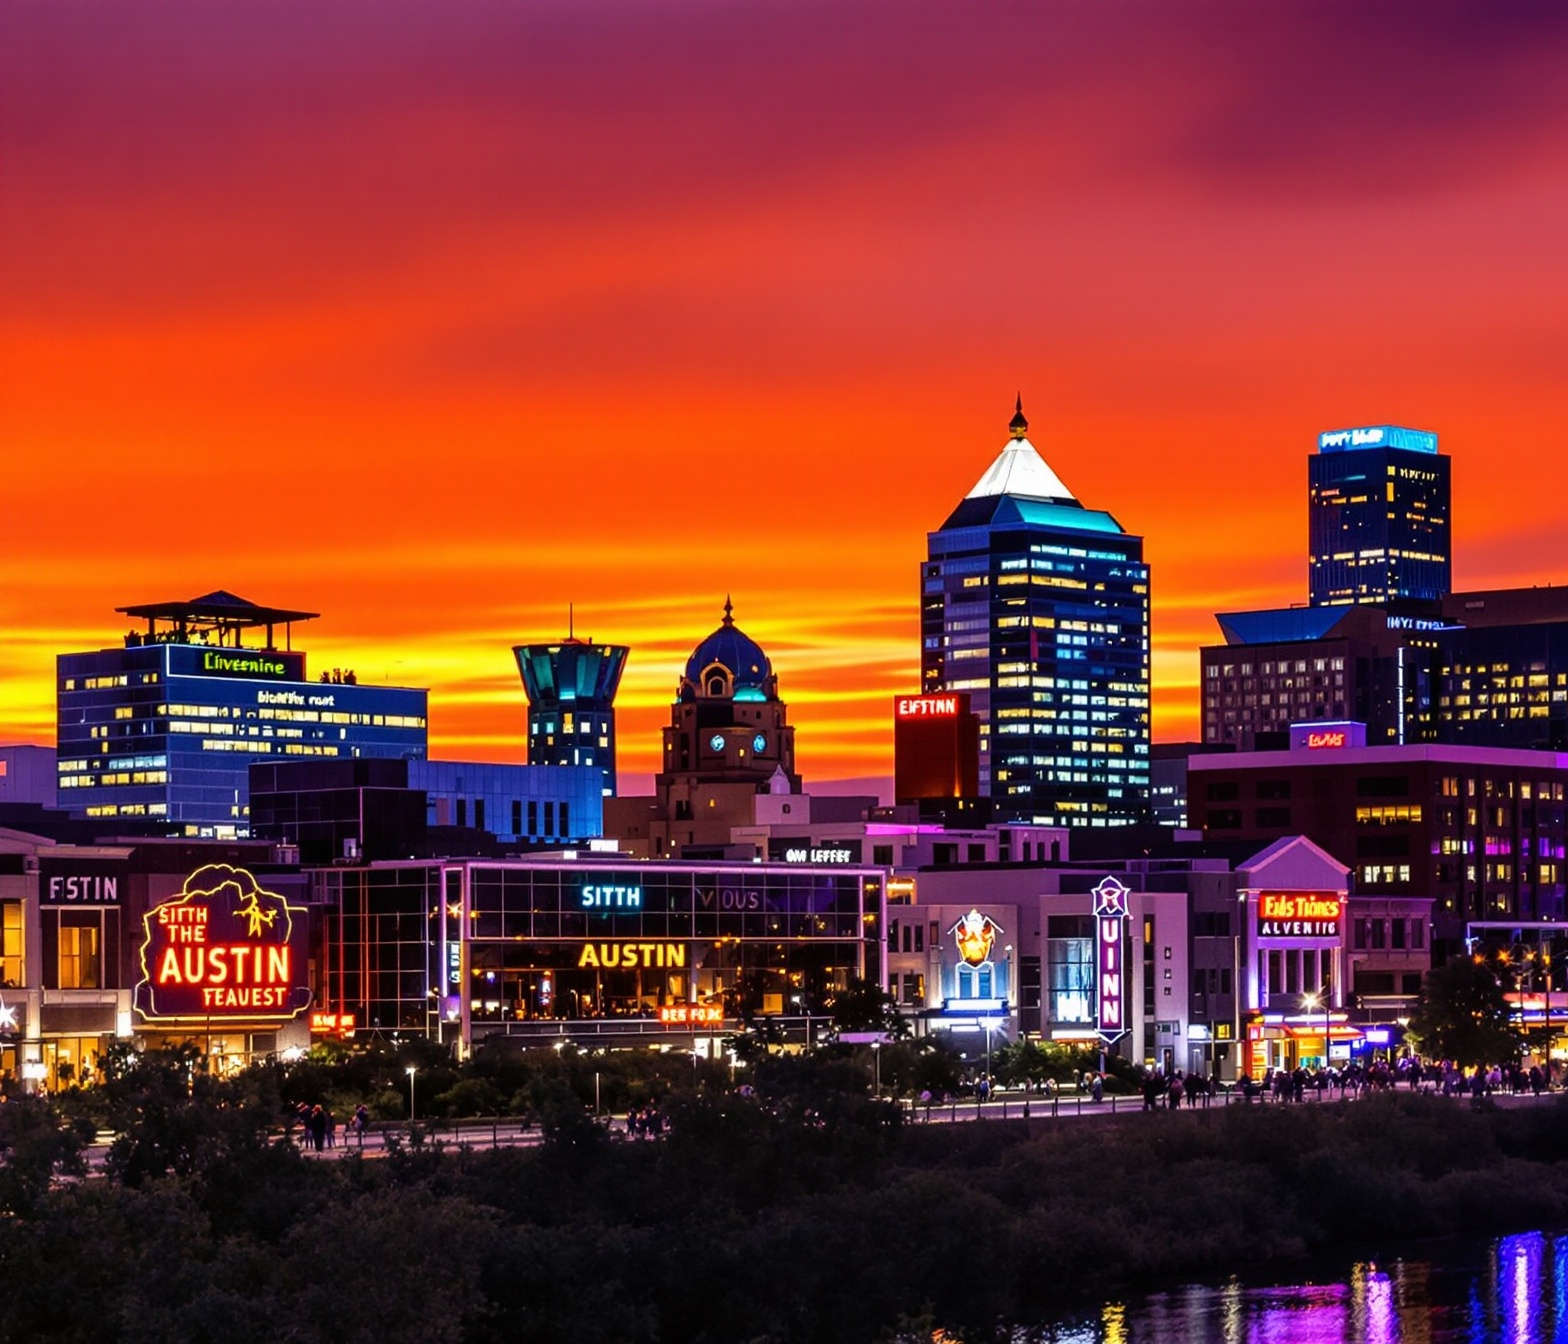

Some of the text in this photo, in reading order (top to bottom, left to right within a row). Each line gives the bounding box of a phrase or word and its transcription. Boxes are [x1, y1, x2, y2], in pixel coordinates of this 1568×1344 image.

[581, 886, 640, 907] SITTH
[167, 924, 206, 943] THE
[159, 946, 290, 984] AUSTIN
[578, 943, 685, 968] AUSTIN
